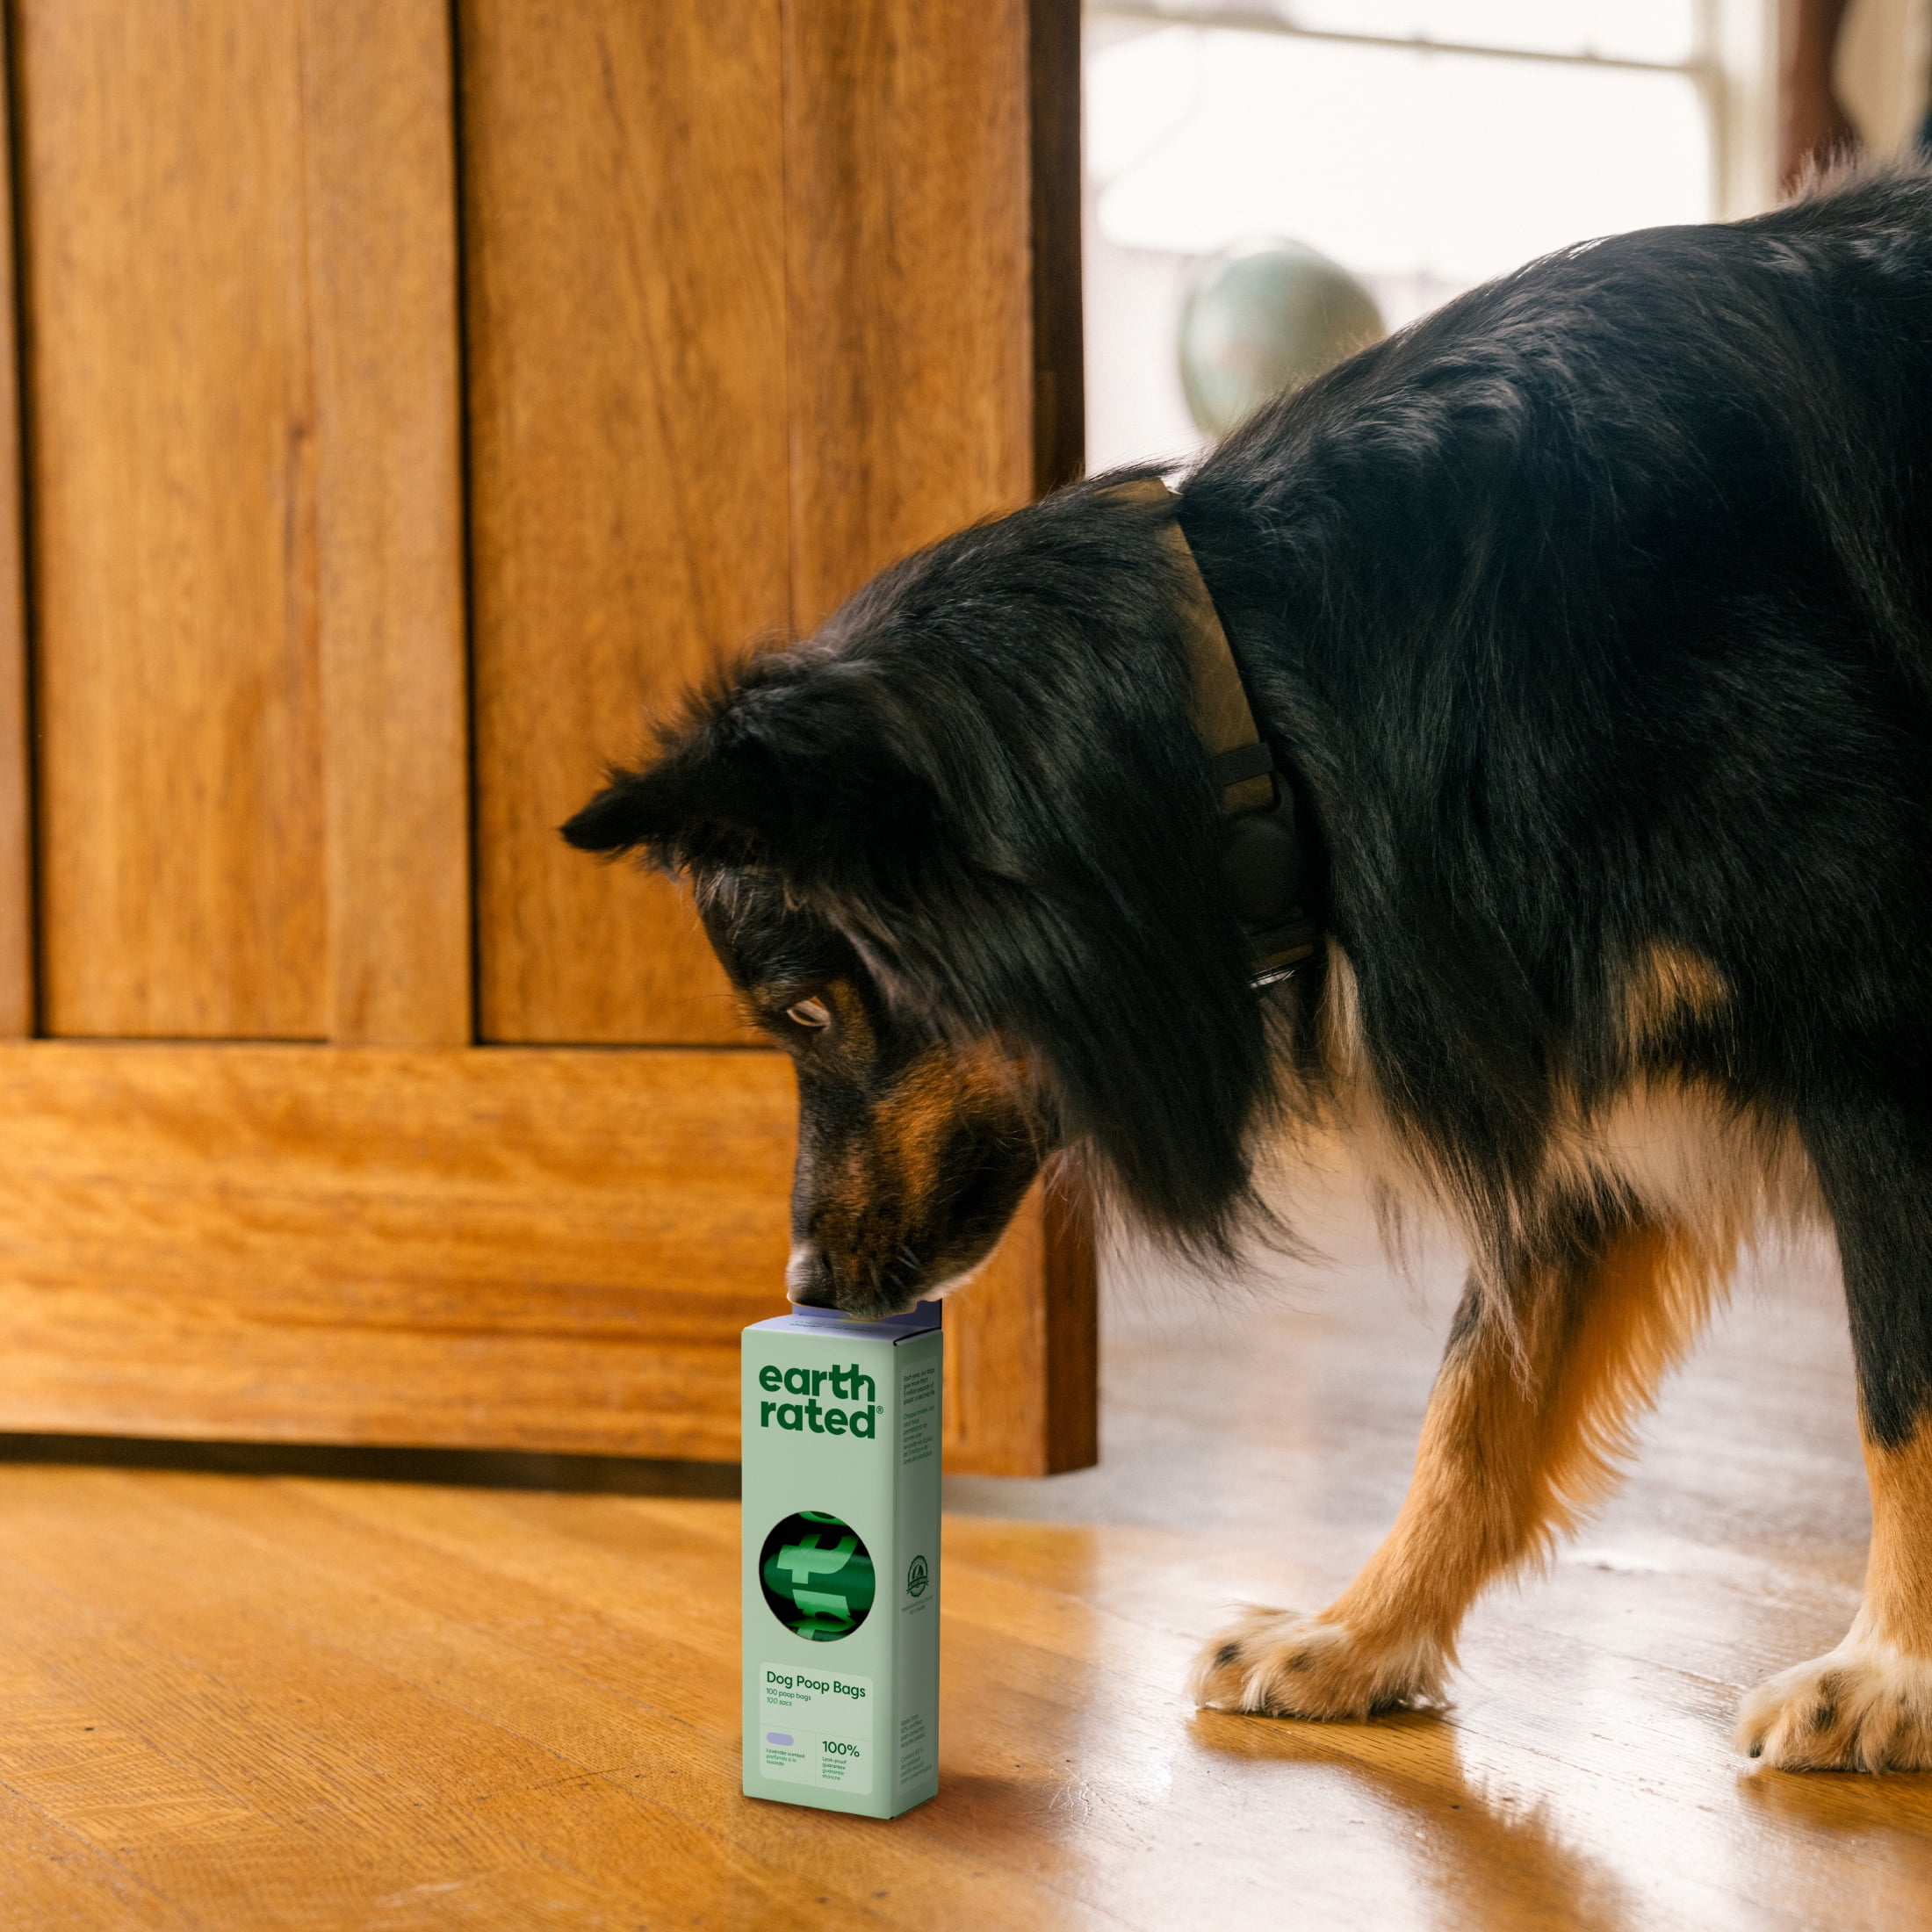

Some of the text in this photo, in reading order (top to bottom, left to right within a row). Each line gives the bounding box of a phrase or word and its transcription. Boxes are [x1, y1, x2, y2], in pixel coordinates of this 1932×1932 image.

[759, 1364, 876, 1402] earth
[767, 1670, 866, 1700] Dog Poop Bags
[796, 1692, 811, 1702] bags
[822, 1741, 861, 1758] 100%
